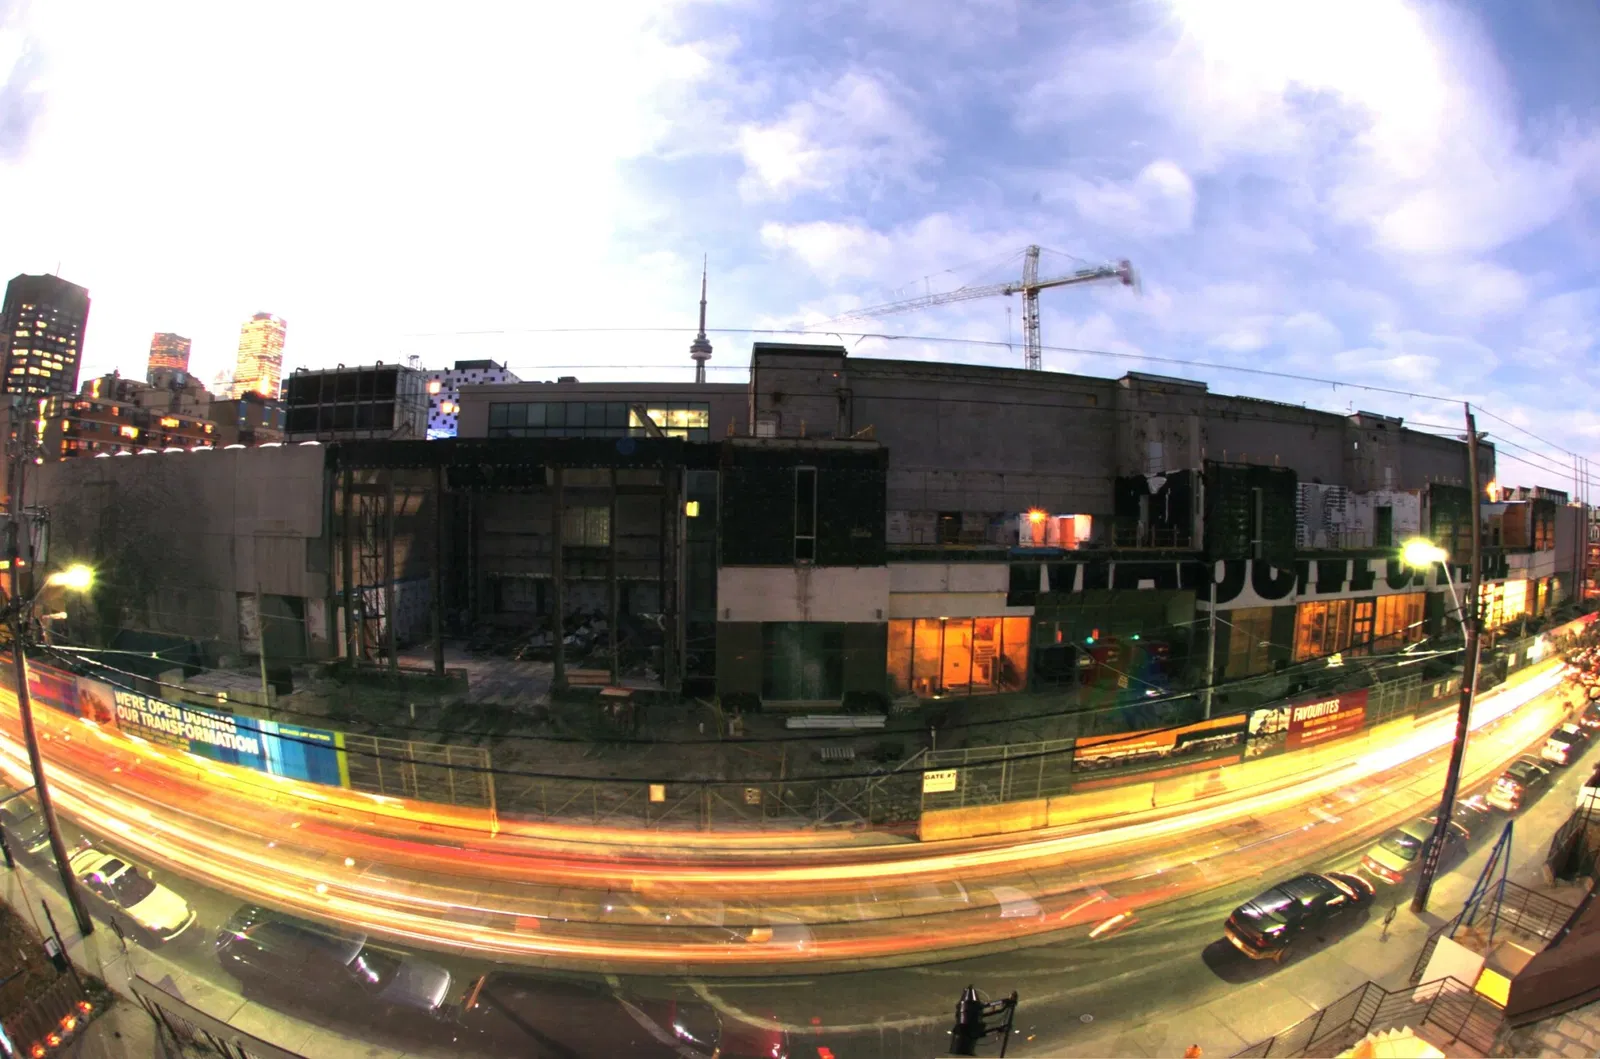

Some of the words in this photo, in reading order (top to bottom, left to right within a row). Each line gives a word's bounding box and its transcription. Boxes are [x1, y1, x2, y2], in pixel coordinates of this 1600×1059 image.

[114, 690, 146, 711] WE'RE
[148, 699, 181, 721] OPEN
[1293, 699, 1340, 722] FAVOURITES
[117, 705, 140, 724] OUR
[141, 712, 259, 755] TRANSFORMATION
